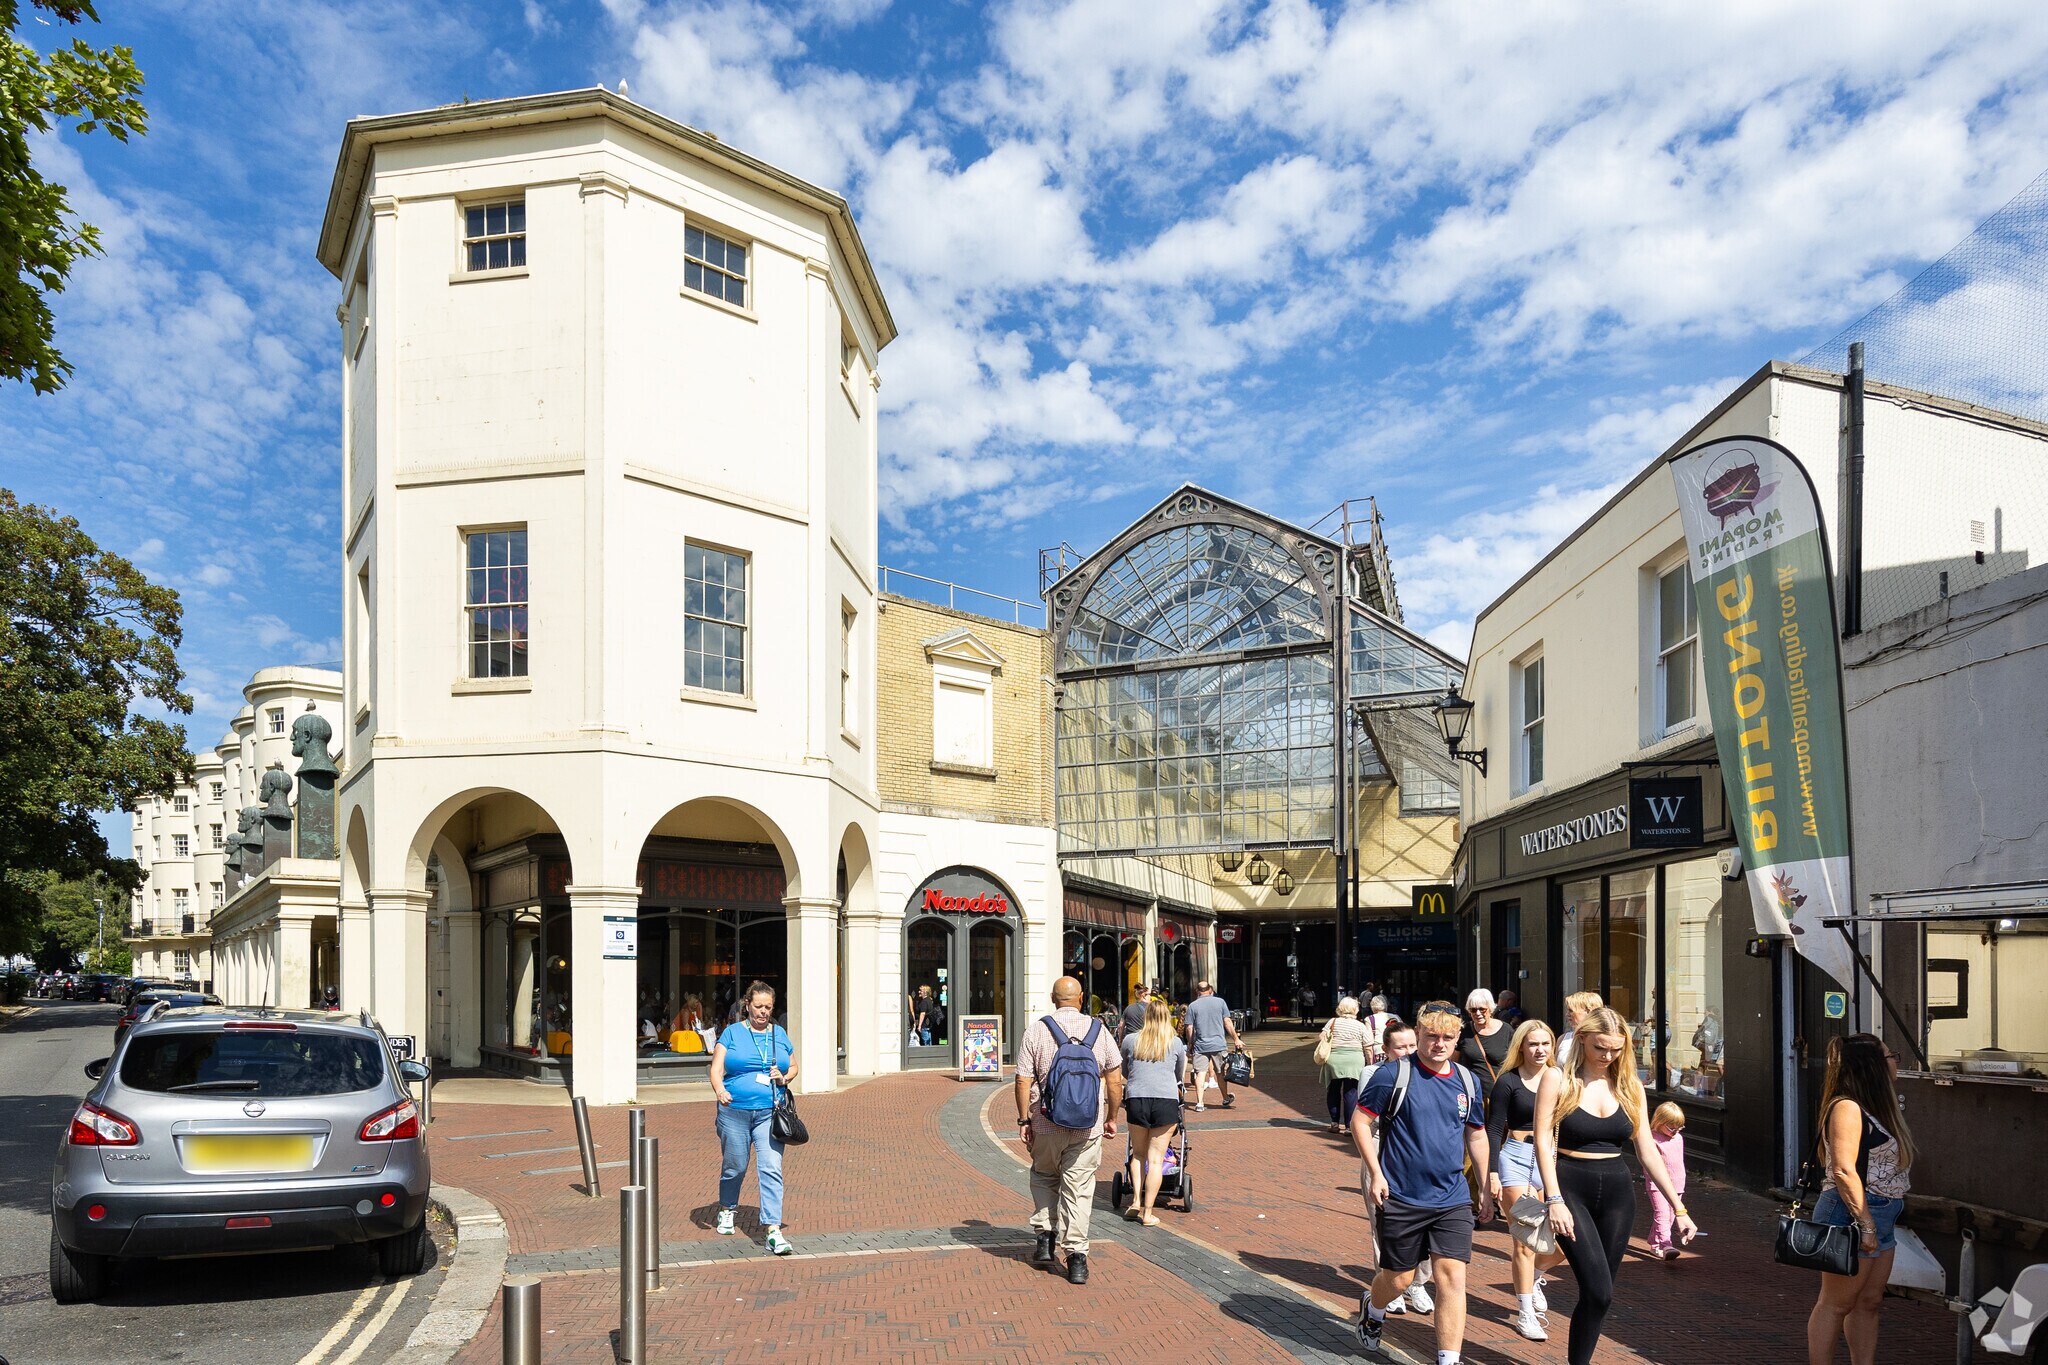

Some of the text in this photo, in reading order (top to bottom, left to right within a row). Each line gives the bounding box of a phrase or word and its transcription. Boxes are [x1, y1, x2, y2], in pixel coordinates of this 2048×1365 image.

[1645, 796, 1685, 824] W
[1520, 804, 1628, 857] WATERSTONES
[1641, 827, 1691, 835] WATERSTONES
[921, 887, 1008, 913] Nando's
[1378, 926, 1433, 937] SLICKS
